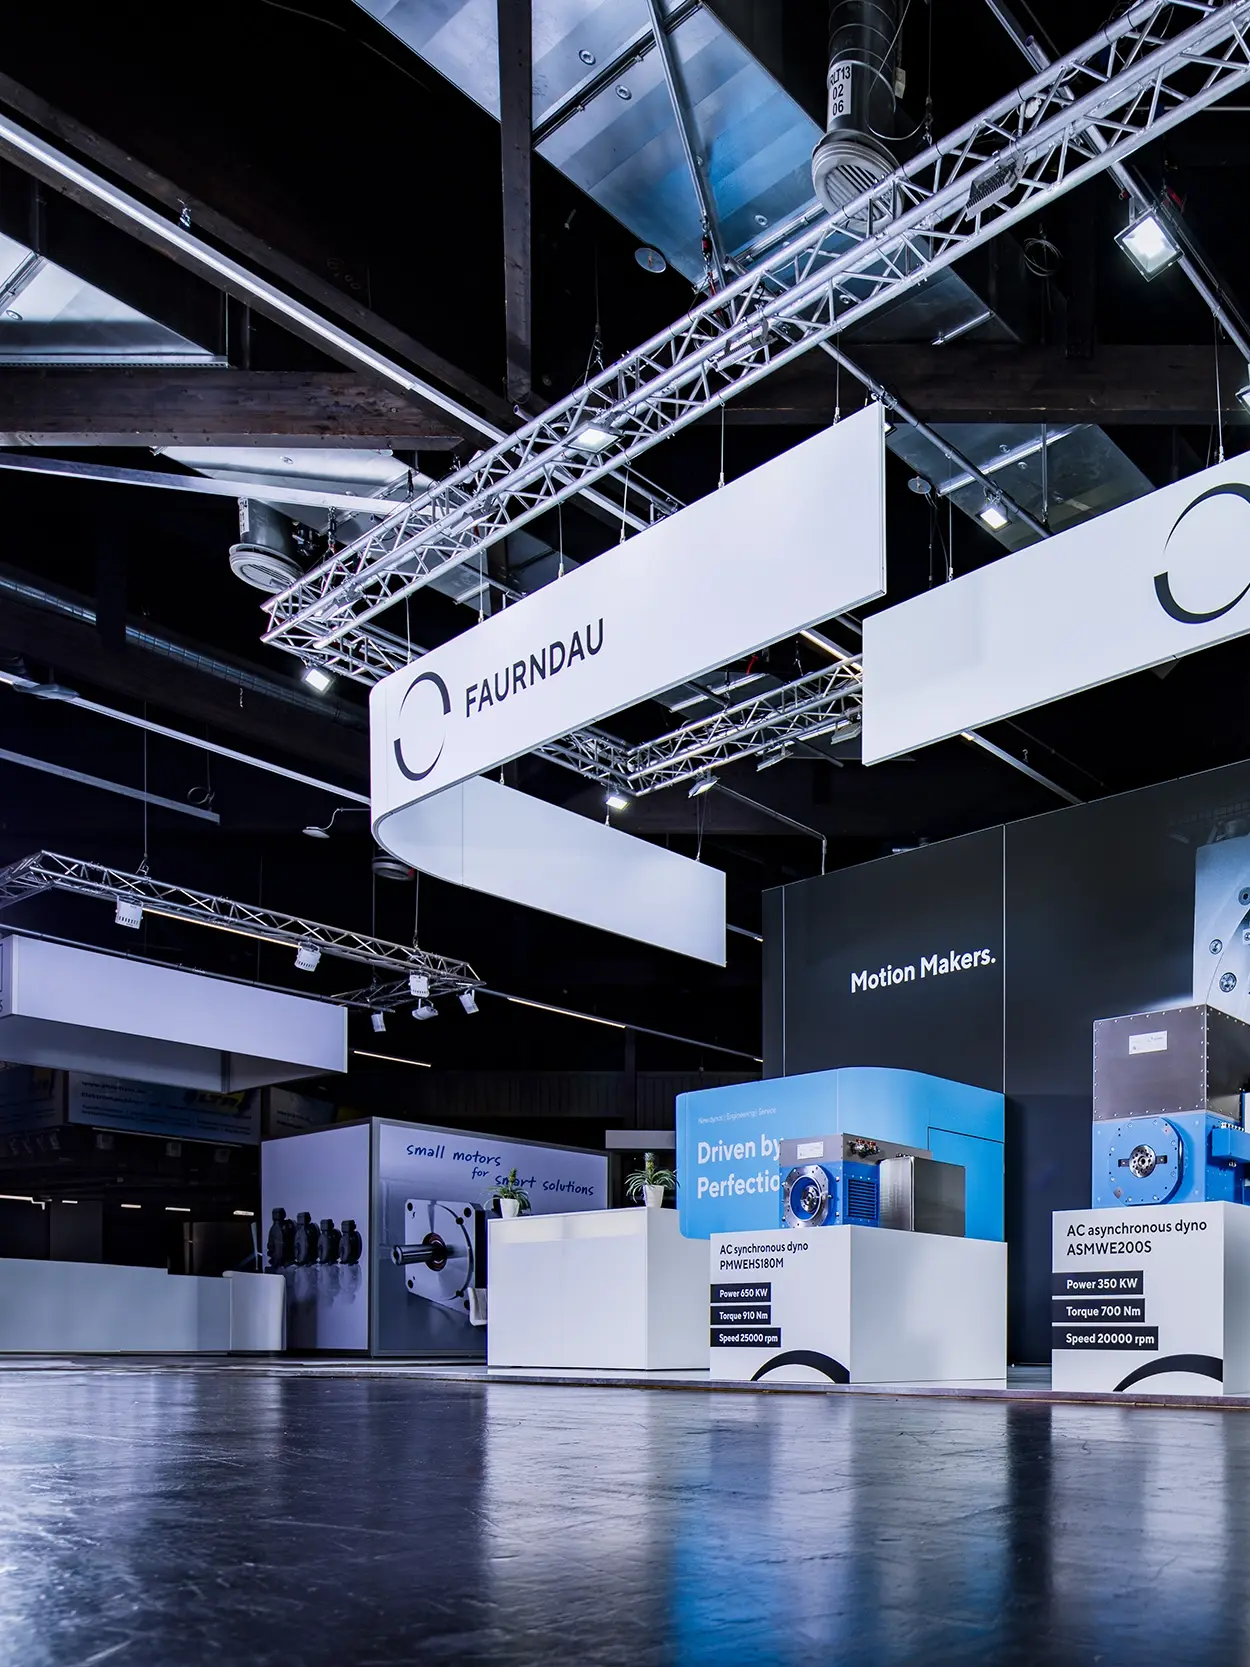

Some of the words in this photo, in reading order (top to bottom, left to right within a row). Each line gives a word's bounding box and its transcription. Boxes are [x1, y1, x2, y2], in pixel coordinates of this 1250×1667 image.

[832, 84, 844, 100] 02
[832, 100, 844, 116] 06
[466, 618, 603, 718] FAURNDAU
[851, 964, 916, 993] Motion
[920, 949, 996, 978] Makers.
[406, 1144, 445, 1159] small
[453, 1150, 501, 1166] motors
[698, 1140, 755, 1164] Driven
[761, 1133, 784, 1161] by
[472, 1167, 489, 1179] for
[542, 1179, 595, 1196] solutions
[697, 1170, 780, 1198] Perfectio
[1067, 1224, 1085, 1236] AC
[1088, 1222, 1172, 1238] asynchronous
[1175, 1219, 1207, 1234] dyno
[720, 1244, 733, 1255] AC
[734, 1244, 786, 1256] synchronous
[787, 1241, 809, 1254] dyno
[1066, 1240, 1152, 1255] ASMWE200S
[720, 1258, 784, 1270] PMWEHS180M
[1066, 1279, 1096, 1289] Power
[1097, 1278, 1117, 1289] 350
[1119, 1278, 1138, 1288] KW
[719, 1289, 740, 1298] Power
[740, 1288, 754, 1298] 650
[755, 1288, 768, 1297] KW
[719, 1311, 742, 1321] Torque
[743, 1311, 755, 1320] 910
[756, 1311, 768, 1320] Nm
[1066, 1306, 1099, 1318] Torque
[1100, 1306, 1121, 1316] 700
[1123, 1306, 1141, 1316] Nm
[719, 1333, 740, 1344] Speed
[740, 1333, 764, 1342] 25000
[764, 1335, 778, 1344] rpm
[1065, 1333, 1096, 1346] Speed
[1097, 1333, 1133, 1344] 20000
[1134, 1335, 1155, 1346] rpm
